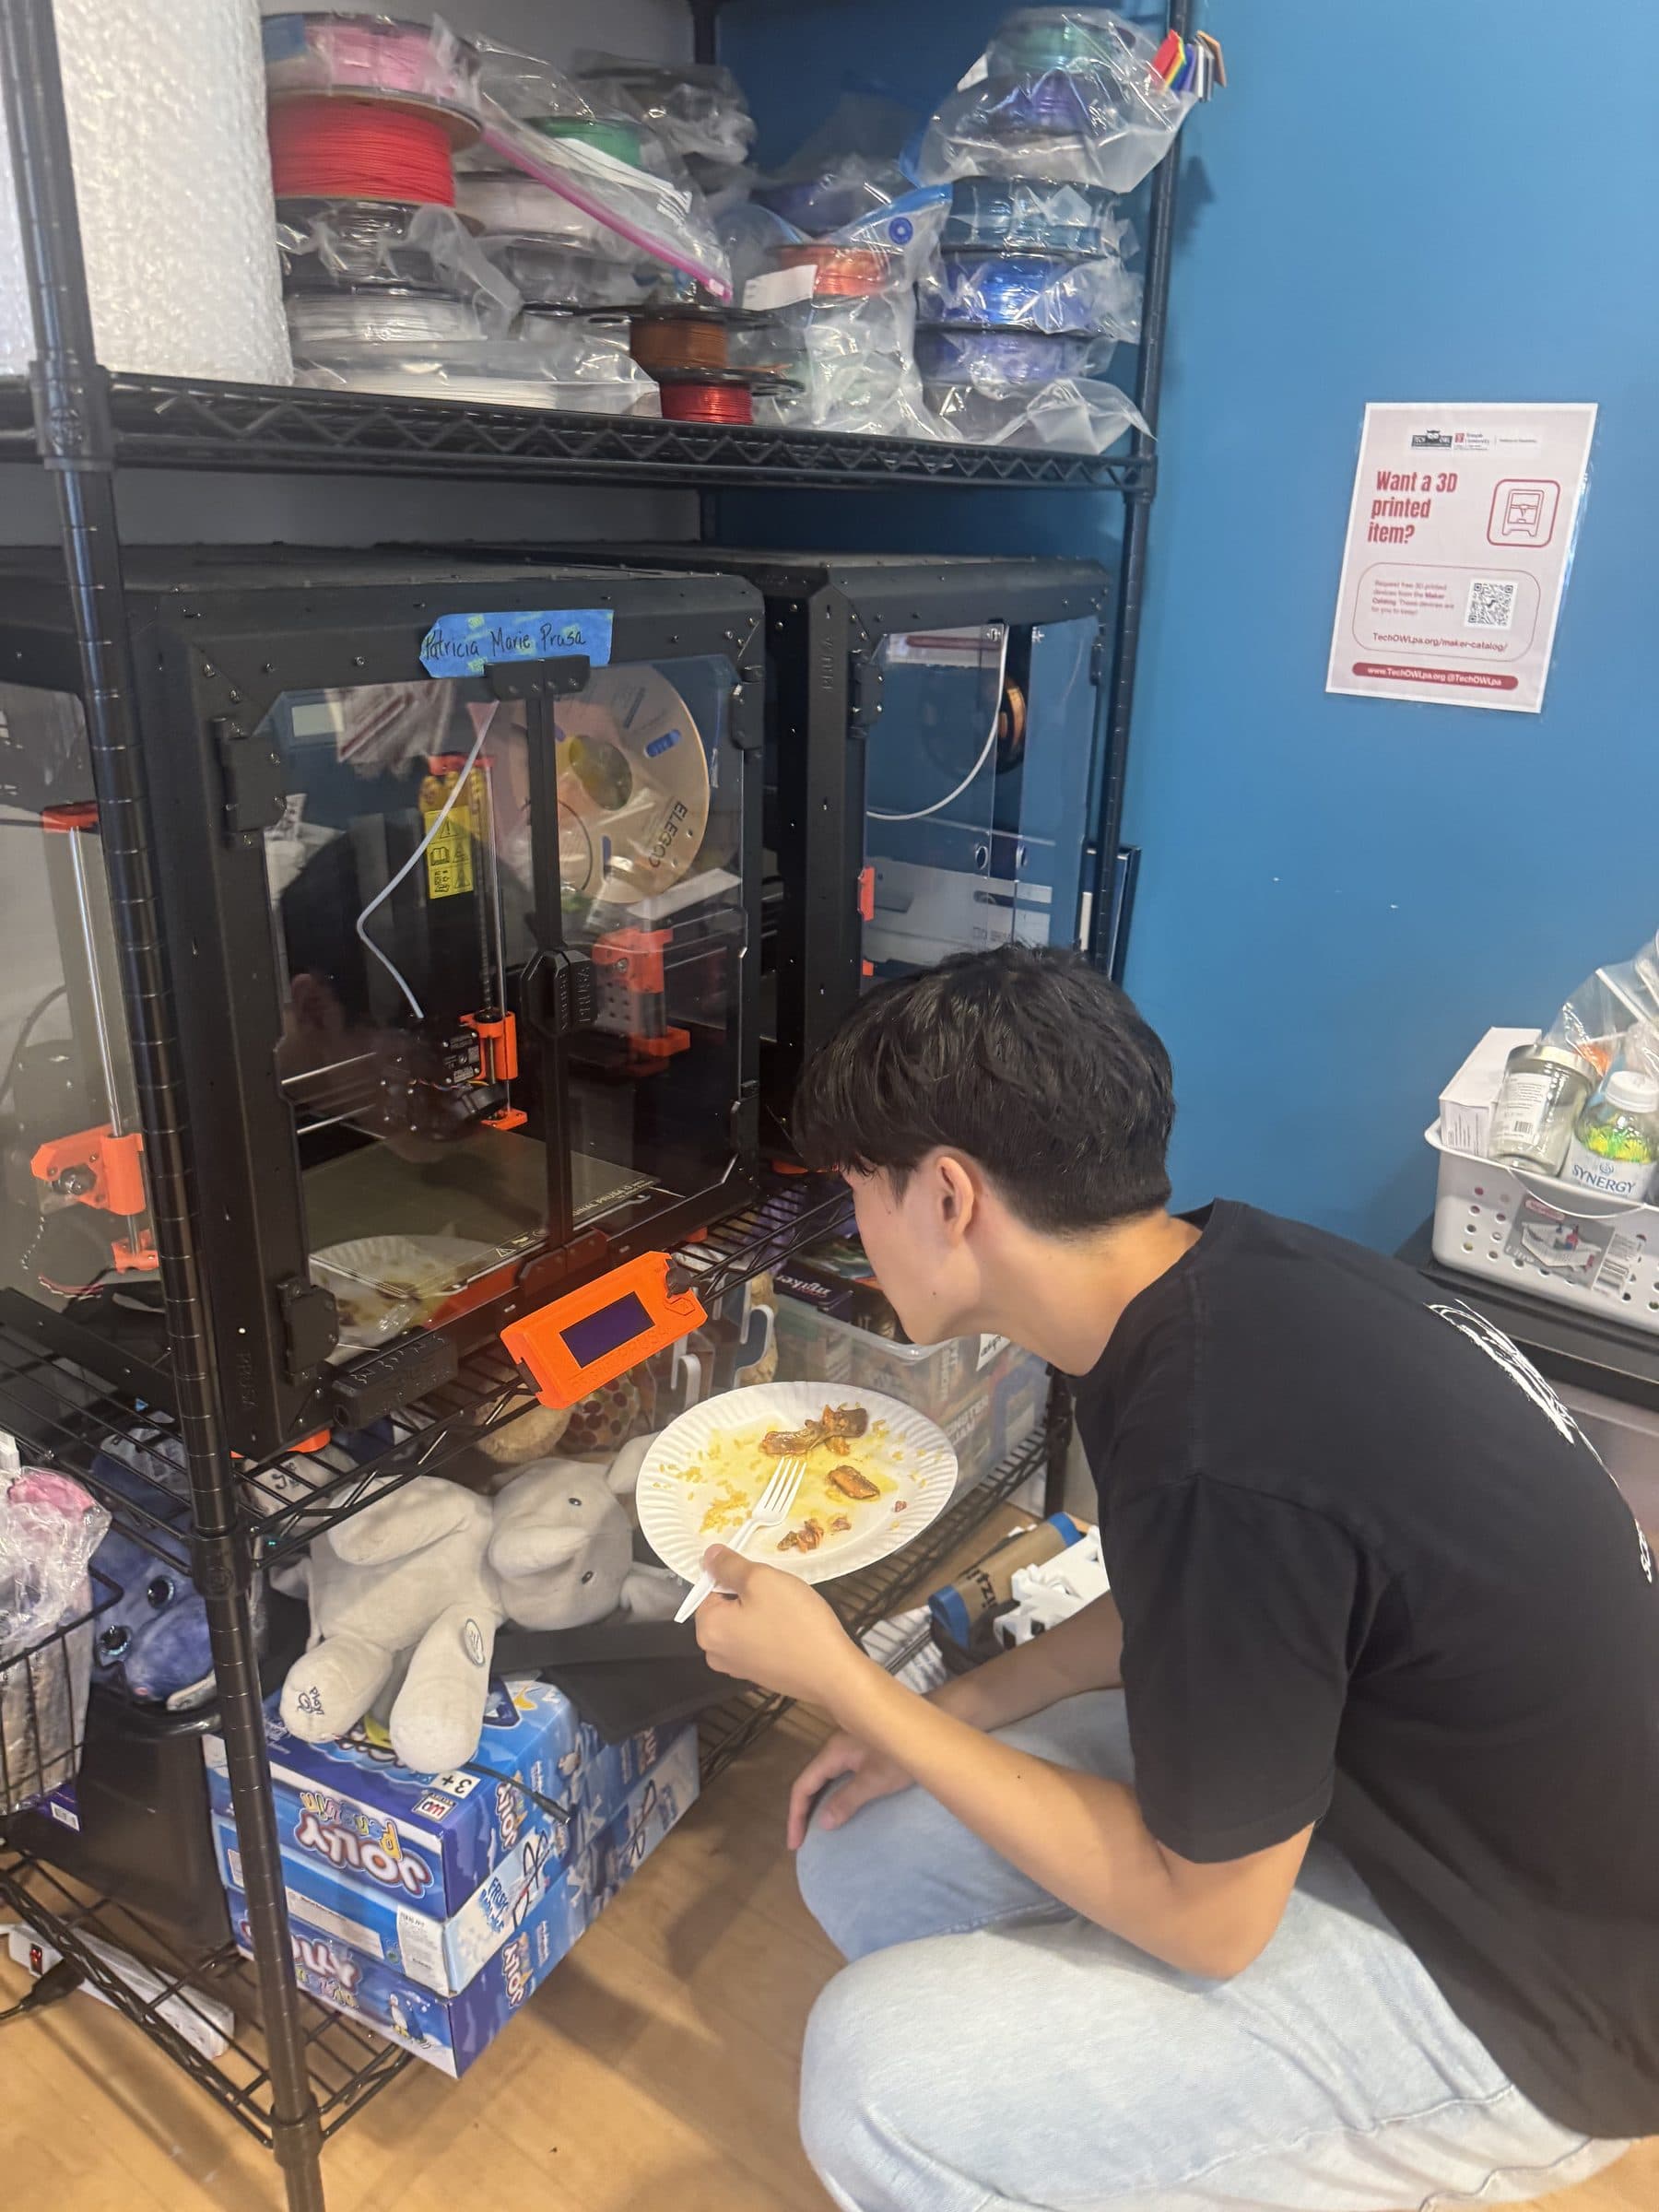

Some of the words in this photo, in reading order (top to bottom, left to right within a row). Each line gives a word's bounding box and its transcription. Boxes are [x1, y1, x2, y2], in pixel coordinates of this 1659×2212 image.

[1376, 471, 1418, 491] Want
[1420, 475, 1432, 492] a
[1436, 472, 1459, 492] 3D
[1371, 496, 1431, 519] printed
[1368, 521, 1415, 544] item?
[426, 629, 480, 660] Patricia
[490, 627, 531, 656] Marie
[540, 622, 586, 651] Prusa
[1372, 632, 1508, 653] TechOWLpa.org/maker-catalog/
[1367, 667, 1446, 682] www.TechOWLpa.org
[1447, 673, 1502, 687] @TechOWLpa
[1572, 1164, 1636, 1194] SYNERGY
[442, 1774, 472, 1794] 3+
[295, 1809, 433, 1897] JOLLY
[502, 1938, 526, 2009] JOLLY
